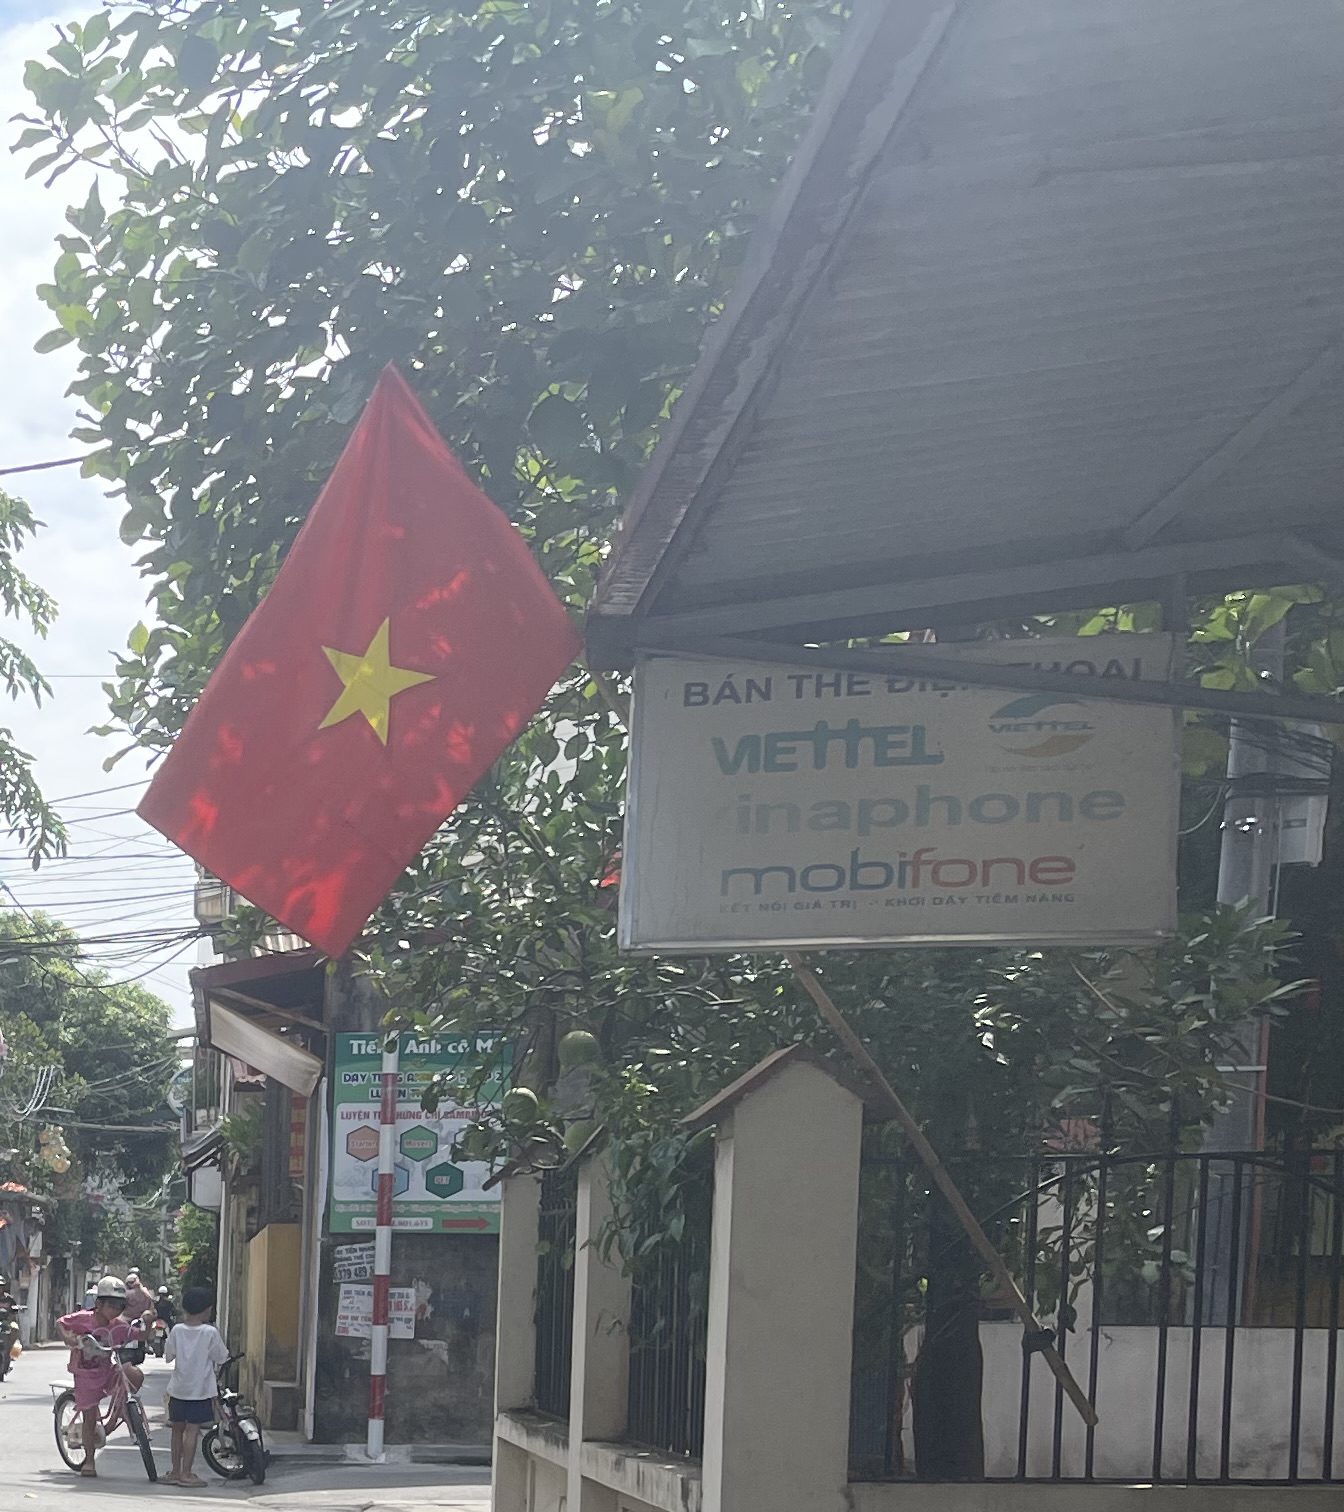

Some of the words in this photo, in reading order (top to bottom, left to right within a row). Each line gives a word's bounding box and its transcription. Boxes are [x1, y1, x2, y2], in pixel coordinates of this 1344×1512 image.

[683, 672, 772, 708] BÁN
[712, 718, 945, 776] VIETTEL
[719, 847, 1077, 897] mobifone
[403, 1039, 443, 1055] Anh
[447, 1039, 470, 1054] cô
